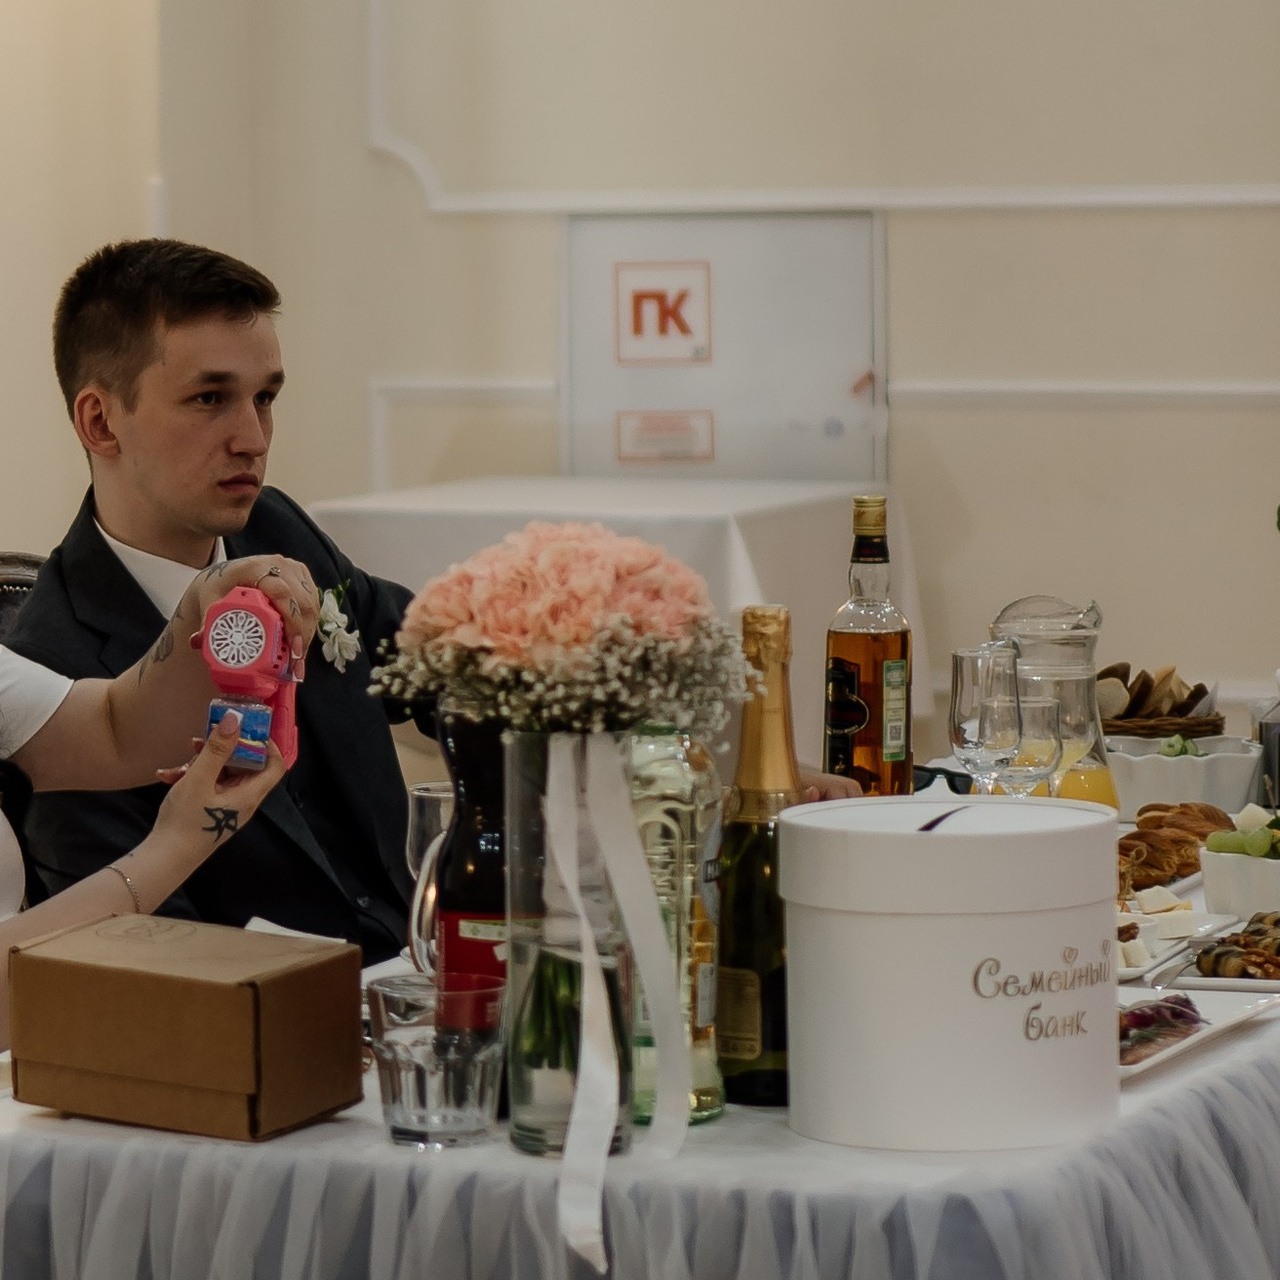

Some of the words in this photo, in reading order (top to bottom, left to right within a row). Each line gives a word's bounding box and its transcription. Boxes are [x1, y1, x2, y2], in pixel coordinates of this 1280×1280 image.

[631, 287, 694, 339] ПК
[972, 939, 1111, 999] Семейный
[1024, 1001, 1088, 1041] банк
